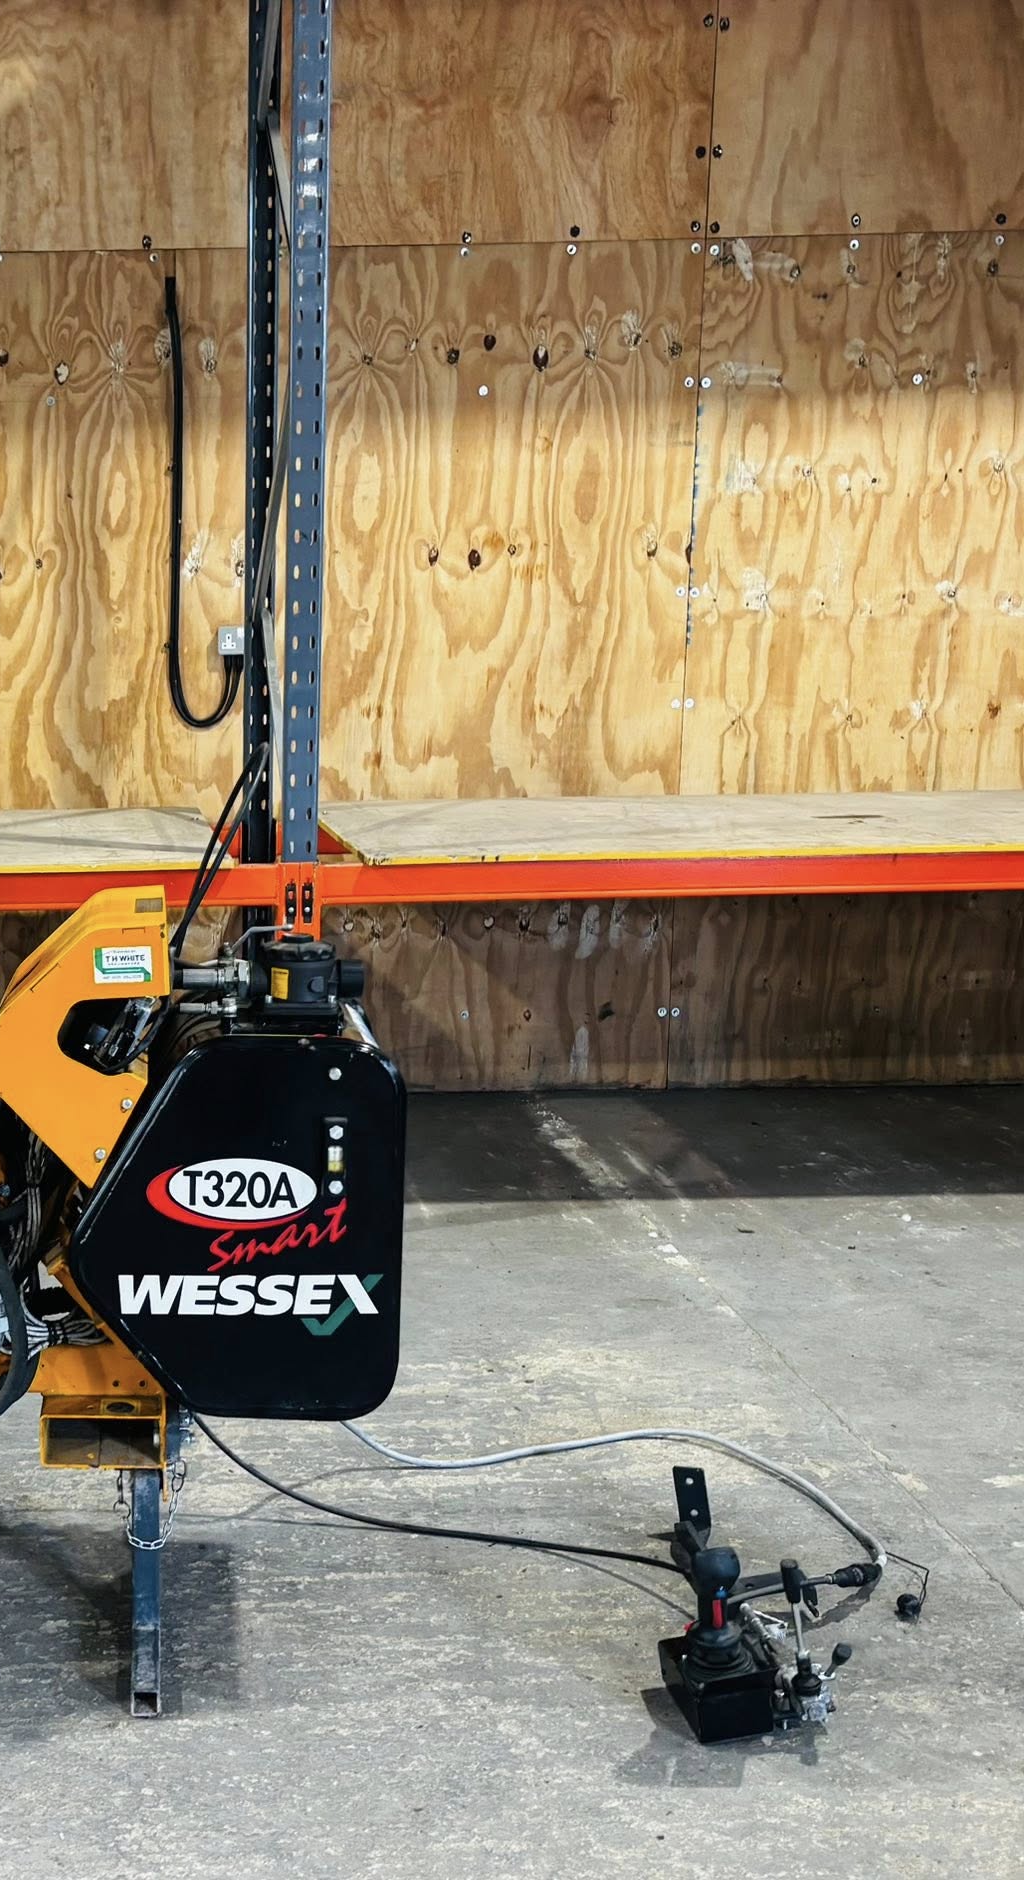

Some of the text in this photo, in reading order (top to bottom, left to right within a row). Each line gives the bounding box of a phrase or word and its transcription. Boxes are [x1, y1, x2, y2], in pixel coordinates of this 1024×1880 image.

[119, 954, 146, 962] WHITE
[182, 1170, 298, 1208] T320A
[207, 1198, 347, 1272] Smart
[118, 1274, 384, 1335] WESSEX
